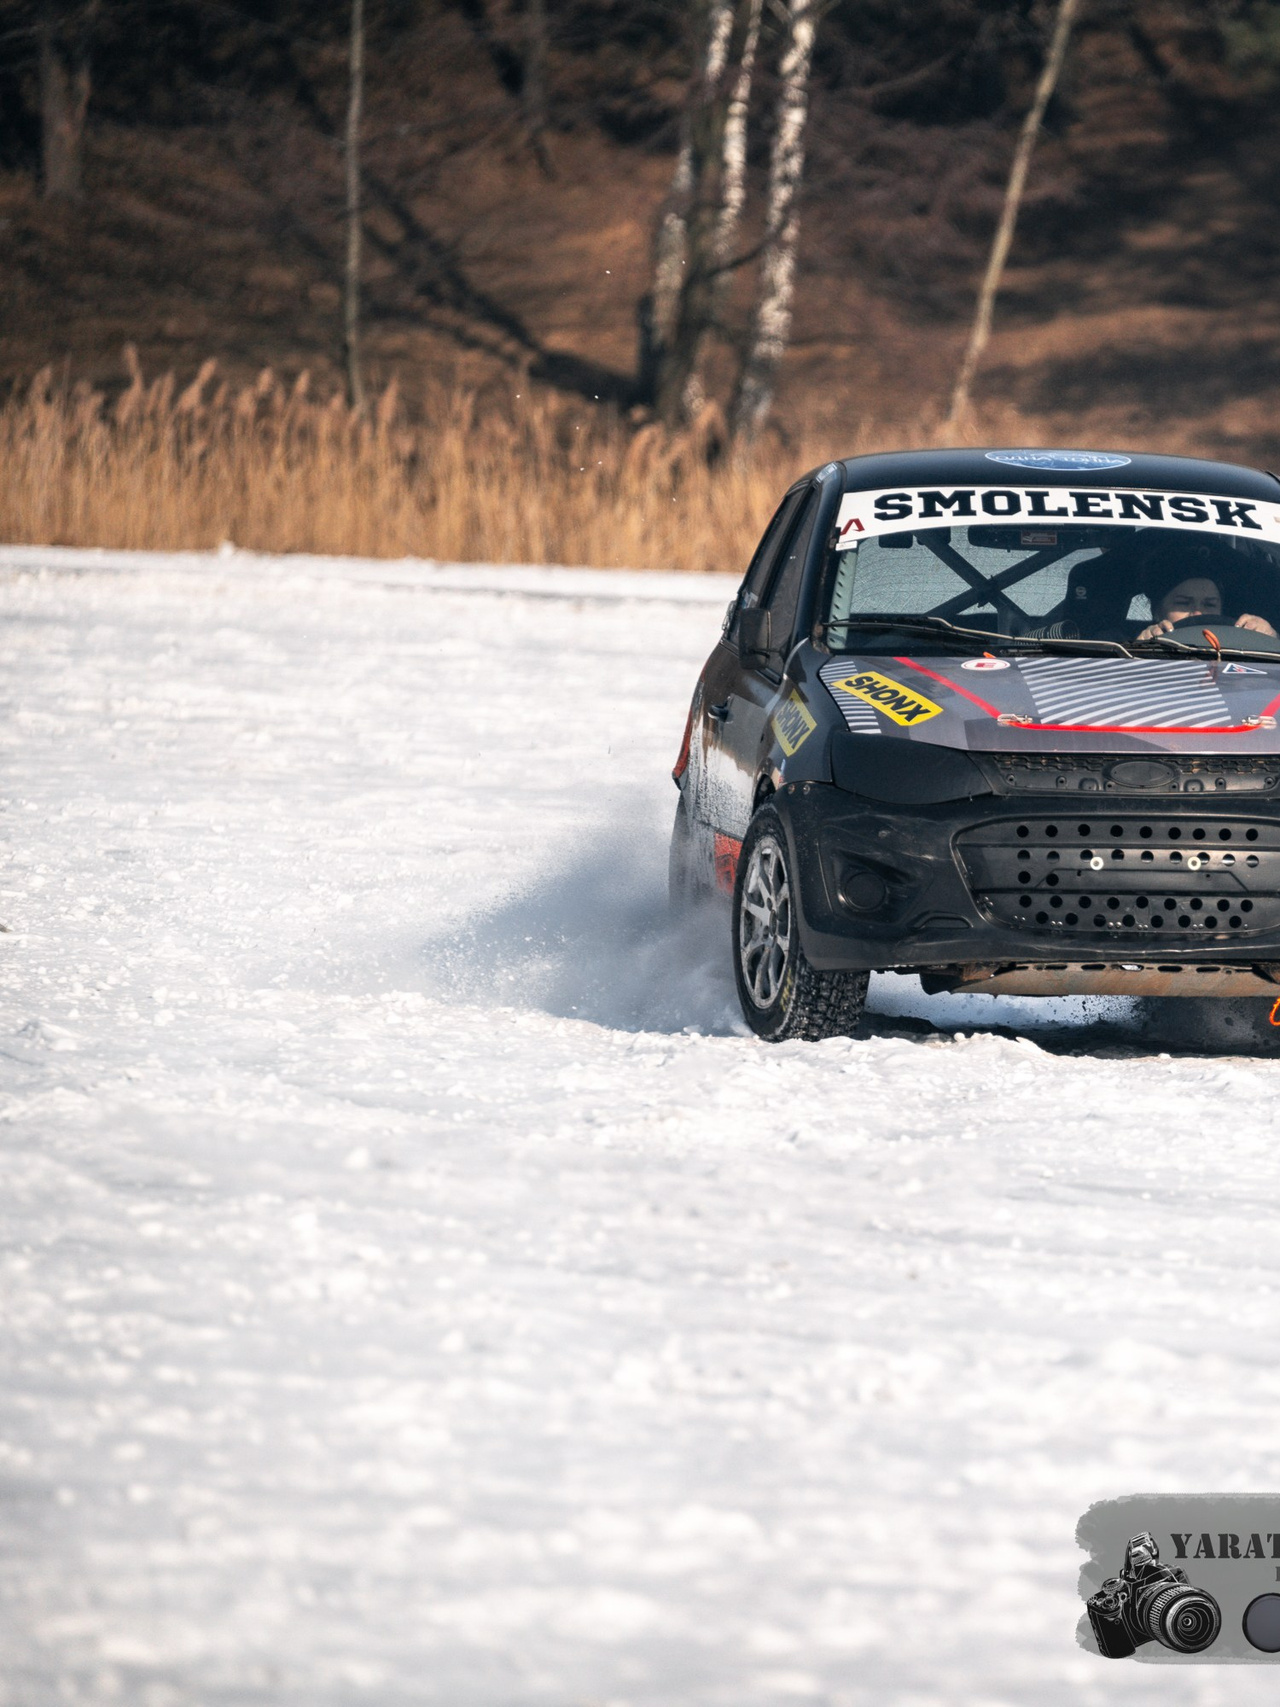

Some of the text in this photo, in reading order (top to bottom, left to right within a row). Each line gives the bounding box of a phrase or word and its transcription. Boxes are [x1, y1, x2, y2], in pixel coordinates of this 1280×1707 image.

[874, 490, 1262, 530] SMOLENSK
[844, 675, 932, 722] SHONX
[776, 698, 810, 750] SHONX
